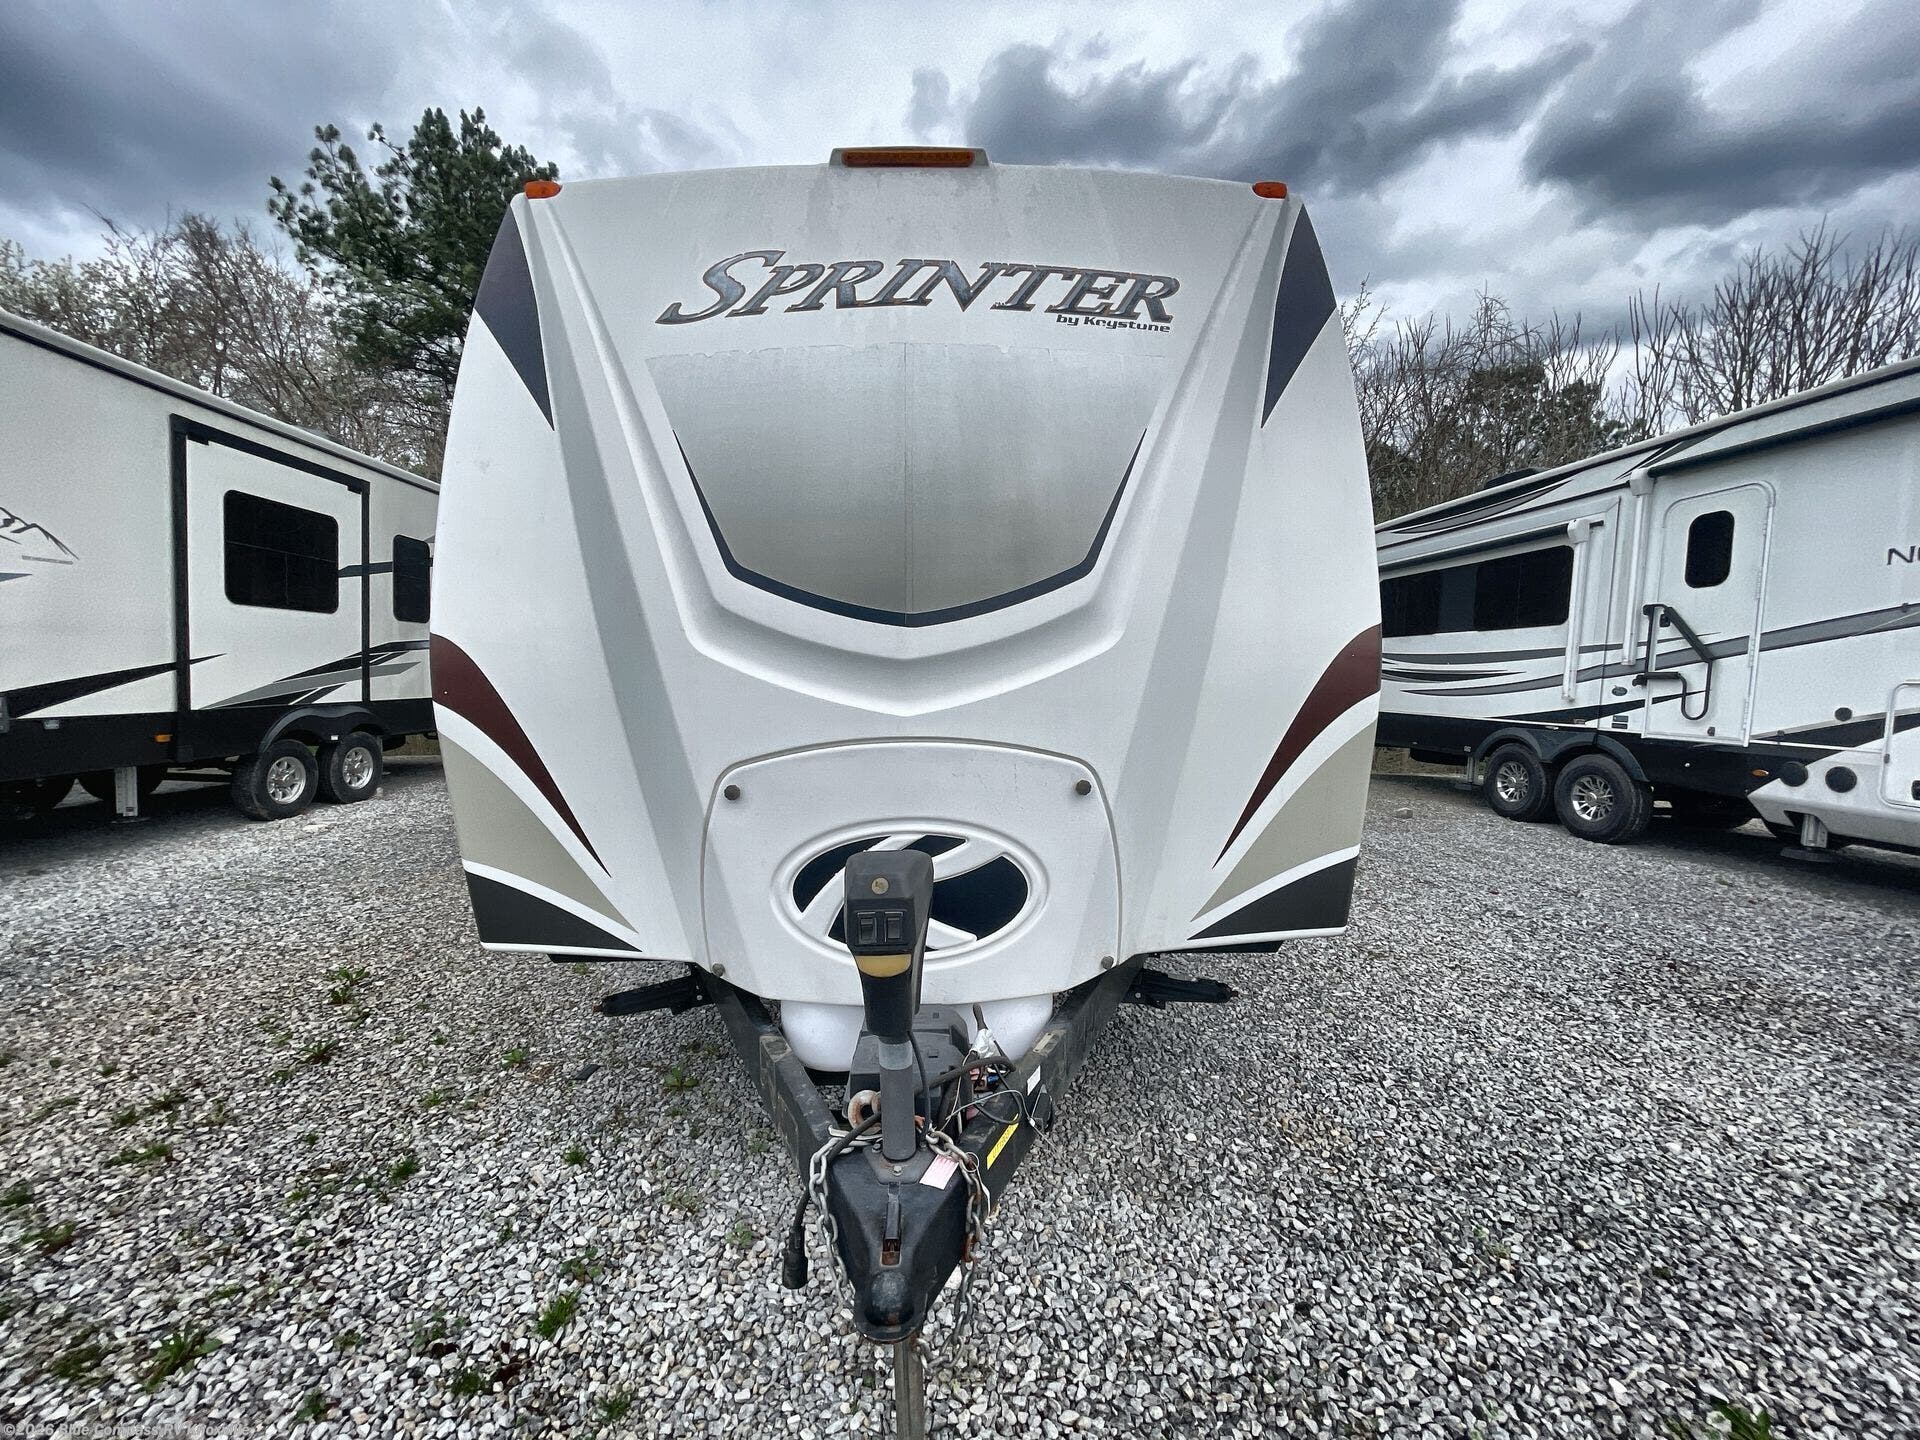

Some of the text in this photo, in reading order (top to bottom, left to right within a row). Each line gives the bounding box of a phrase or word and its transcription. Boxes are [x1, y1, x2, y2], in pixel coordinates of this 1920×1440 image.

[655, 249, 1180, 324] SPRINTER
[1056, 314, 1079, 327] by
[1886, 545, 1920, 566] N
